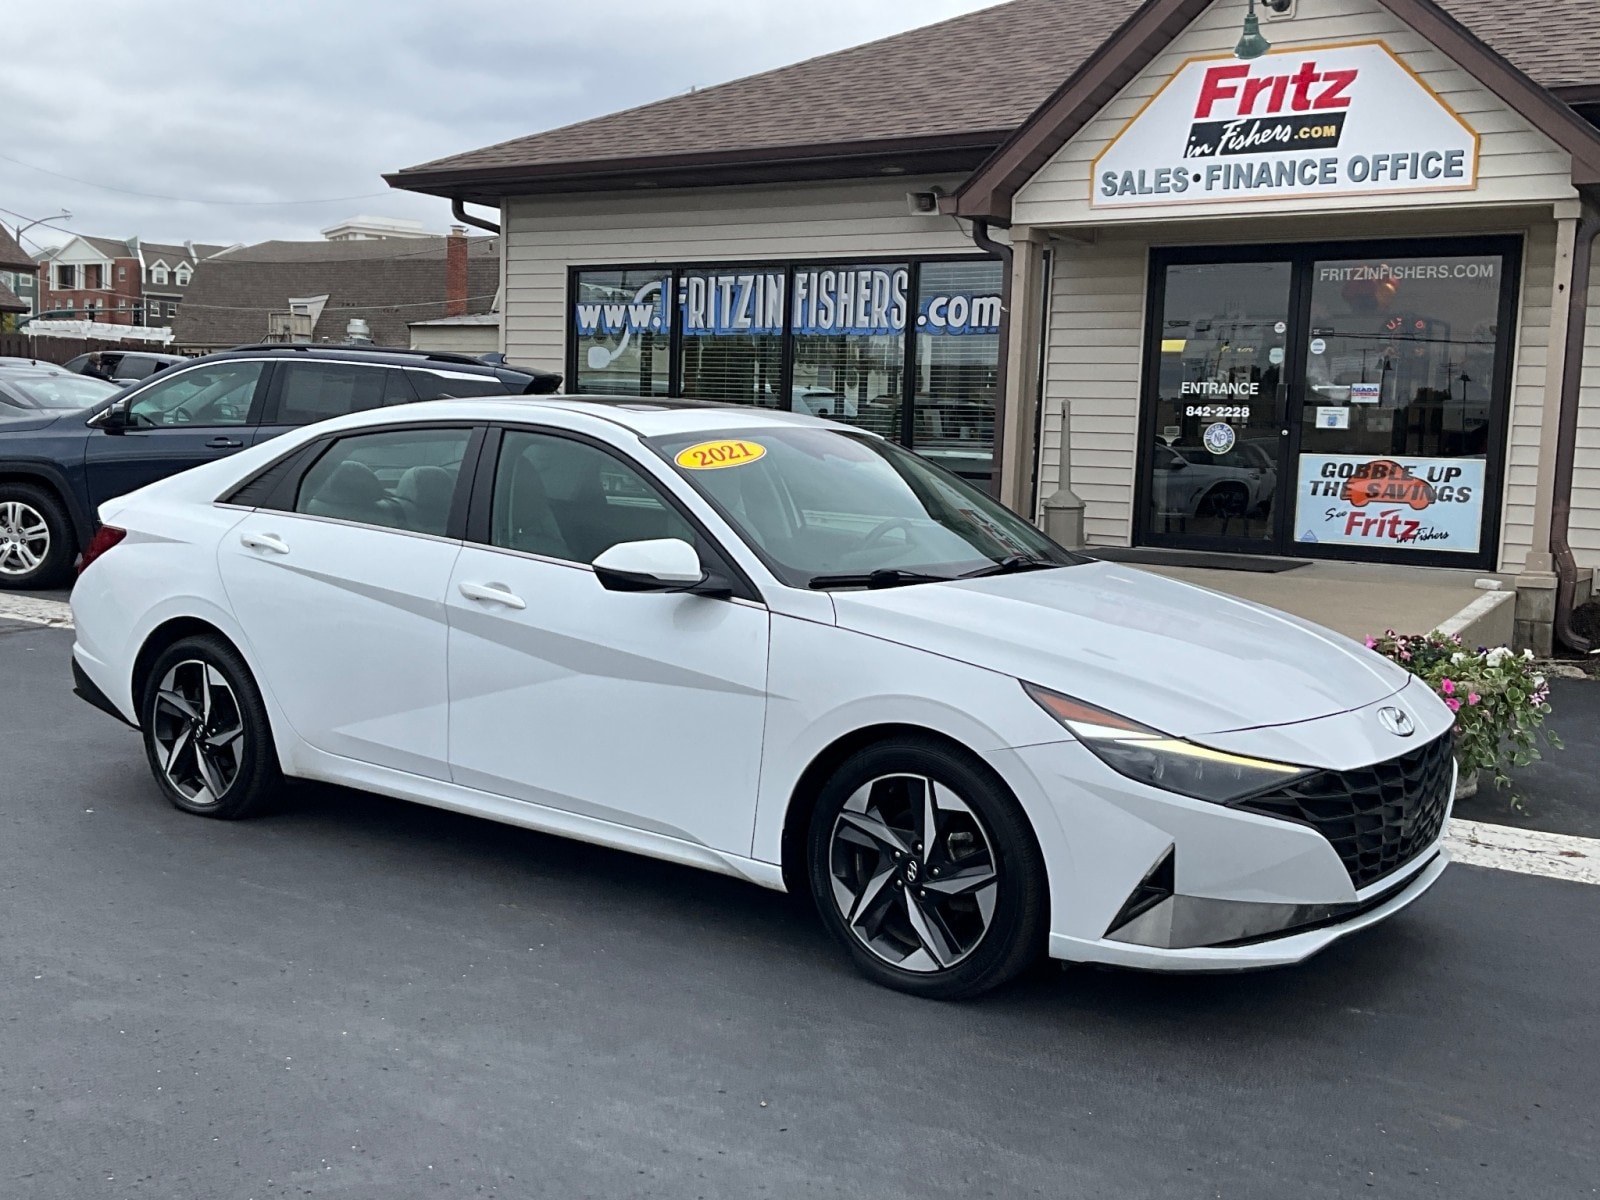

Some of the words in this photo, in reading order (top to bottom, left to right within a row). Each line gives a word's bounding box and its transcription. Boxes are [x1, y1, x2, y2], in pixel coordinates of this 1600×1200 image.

[1194, 62, 1358, 118] Fritz
[1187, 136, 1213, 157] in
[1347, 150, 1465, 182] OFFICE
[1319, 264, 1494, 281] FRITZINFISHERS.COM
[1181, 382, 1260, 395] ENTRANCE
[1185, 406, 1250, 417] 842-2228
[693, 443, 753, 467] 2021
[1320, 462, 1416, 481] GOBBLE
[1426, 466, 1462, 483] UP
[1309, 480, 1354, 497] THE
[1365, 483, 1472, 503] SAVINGS
[1344, 509, 1421, 541] Fritz
[1412, 527, 1449, 545] Fishers
